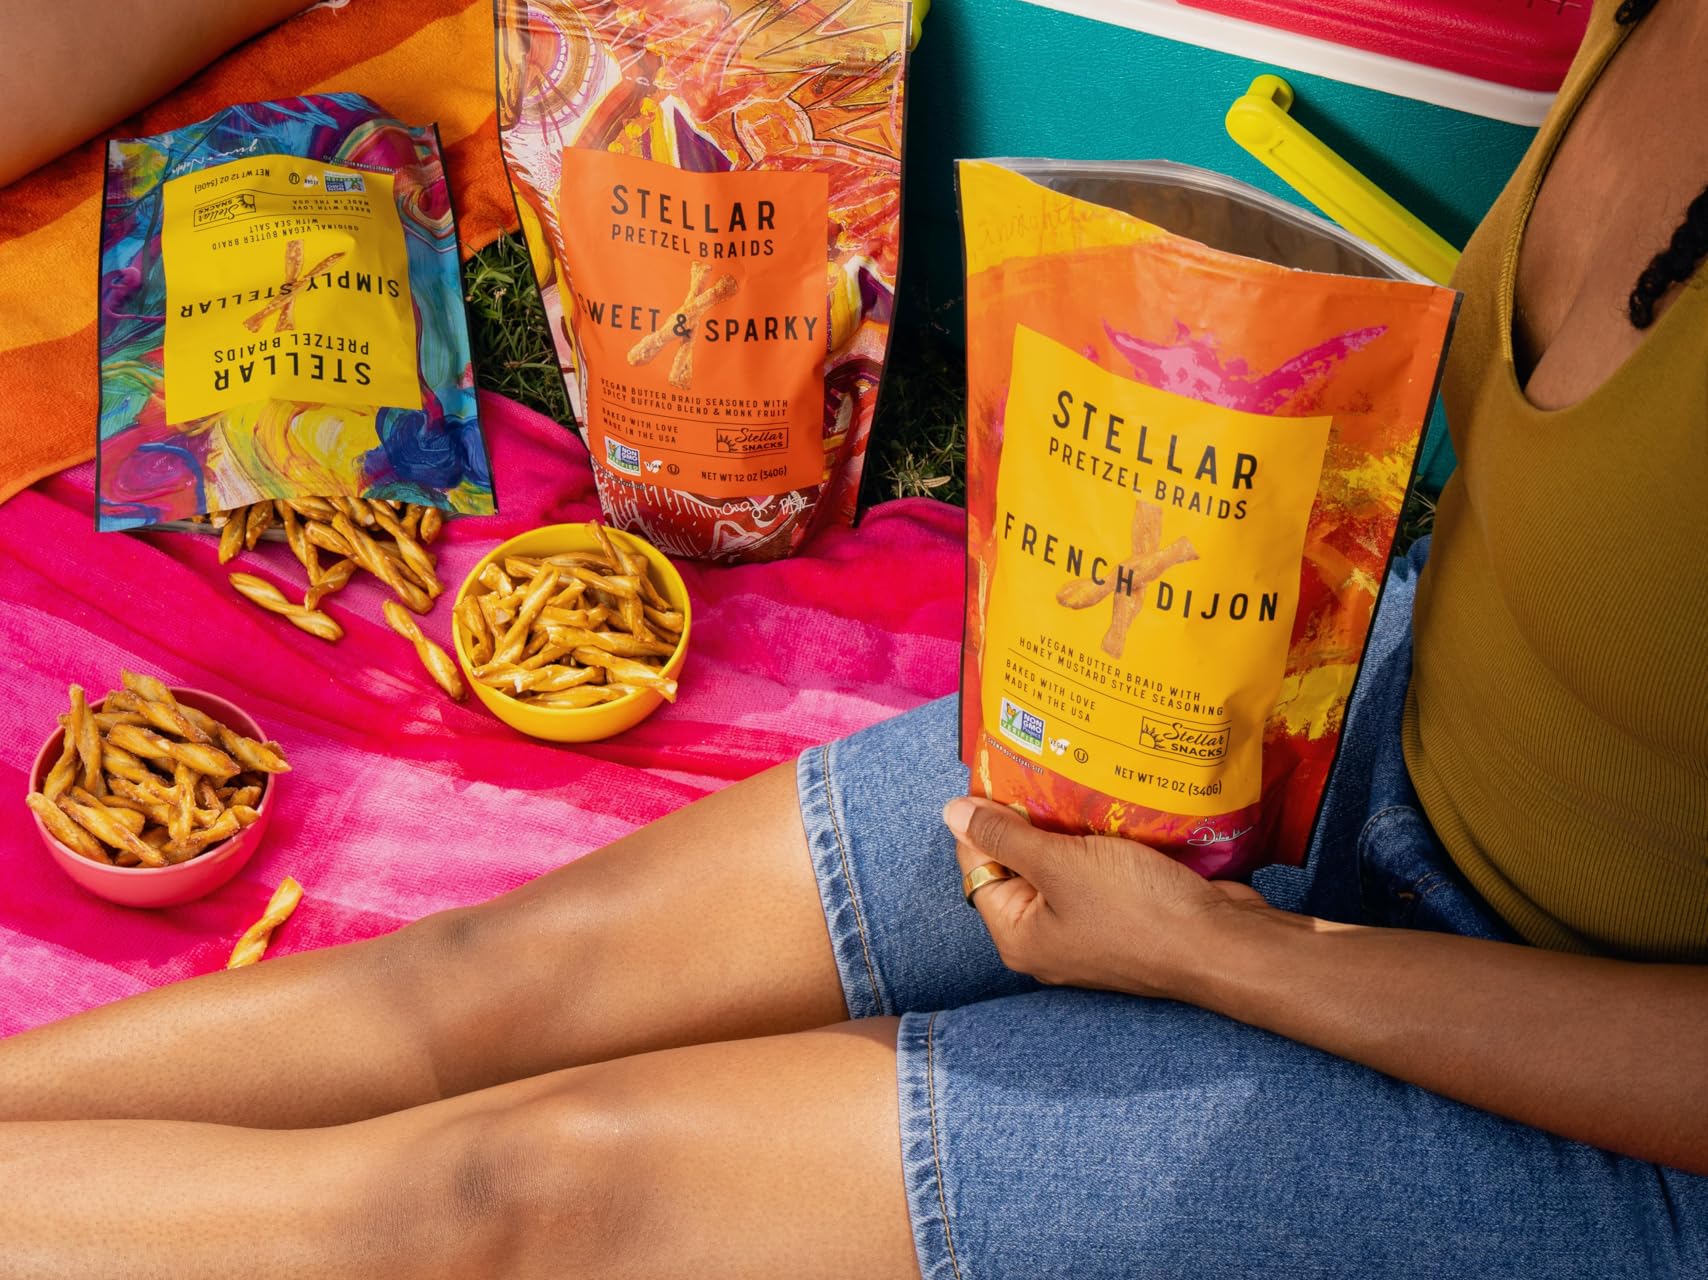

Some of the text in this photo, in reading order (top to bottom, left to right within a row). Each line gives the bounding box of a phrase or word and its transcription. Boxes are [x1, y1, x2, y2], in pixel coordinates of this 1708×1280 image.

[220, 175, 229, 184] OZ
[230, 173, 240, 182] 12
[241, 170, 253, 178] WT
[255, 168, 270, 177] NET
[198, 198, 233, 214] SNACKS
[198, 203, 239, 222] Stellar
[610, 184, 776, 233] STELLAR
[249, 222, 270, 233] SALT
[274, 219, 291, 228] SEA
[282, 226, 312, 236] VEGAN
[212, 238, 239, 250] BRAID
[243, 230, 278, 244] BUTTER
[611, 223, 774, 259] PRETZEL BRAIDS
[180, 270, 400, 318] SIMPLY STELLAR
[672, 313, 692, 338] &
[705, 316, 818, 342] SPARKY
[214, 333, 369, 364] PRETZEL BRAIDS
[214, 352, 372, 391] STELLAR
[601, 378, 788, 408] VEGAN BUTTER BRAID SEASONED WITH
[602, 387, 786, 417] SPICY BUFFALO BLEND & MONK FRUIT
[602, 407, 679, 433] BAKED WITH LOVE
[603, 417, 676, 444] MADE IN THE USA
[735, 427, 784, 443] Stellar
[1052, 389, 1258, 490] STELLAR
[621, 447, 637, 457] NON
[741, 441, 783, 451] SNACKS
[701, 471, 717, 481] NET
[719, 473, 732, 482] WT
[735, 474, 745, 482] 12
[746, 472, 758, 482] OZ
[1049, 436, 1248, 520] PRETZEL BRAIDS
[1004, 511, 1278, 622] FRENCH DIJON
[1019, 636, 1224, 716] HONEY MUSTARD STYLE SEASONING
[1040, 634, 1201, 702] VEGAN BUTTER BRAID WITH
[1006, 659, 1096, 710] BAKED WITH LOVE
[1004, 672, 1091, 723] MADE IN THE USA
[1023, 713, 1043, 727] NON
[1023, 720, 1042, 733] GMO
[1163, 722, 1225, 746] Stellar
[1050, 739, 1067, 751] VEGAN
[1170, 743, 1223, 758] SNACKS
[1114, 765, 1222, 797] NET WT 12 OZ (340G)
